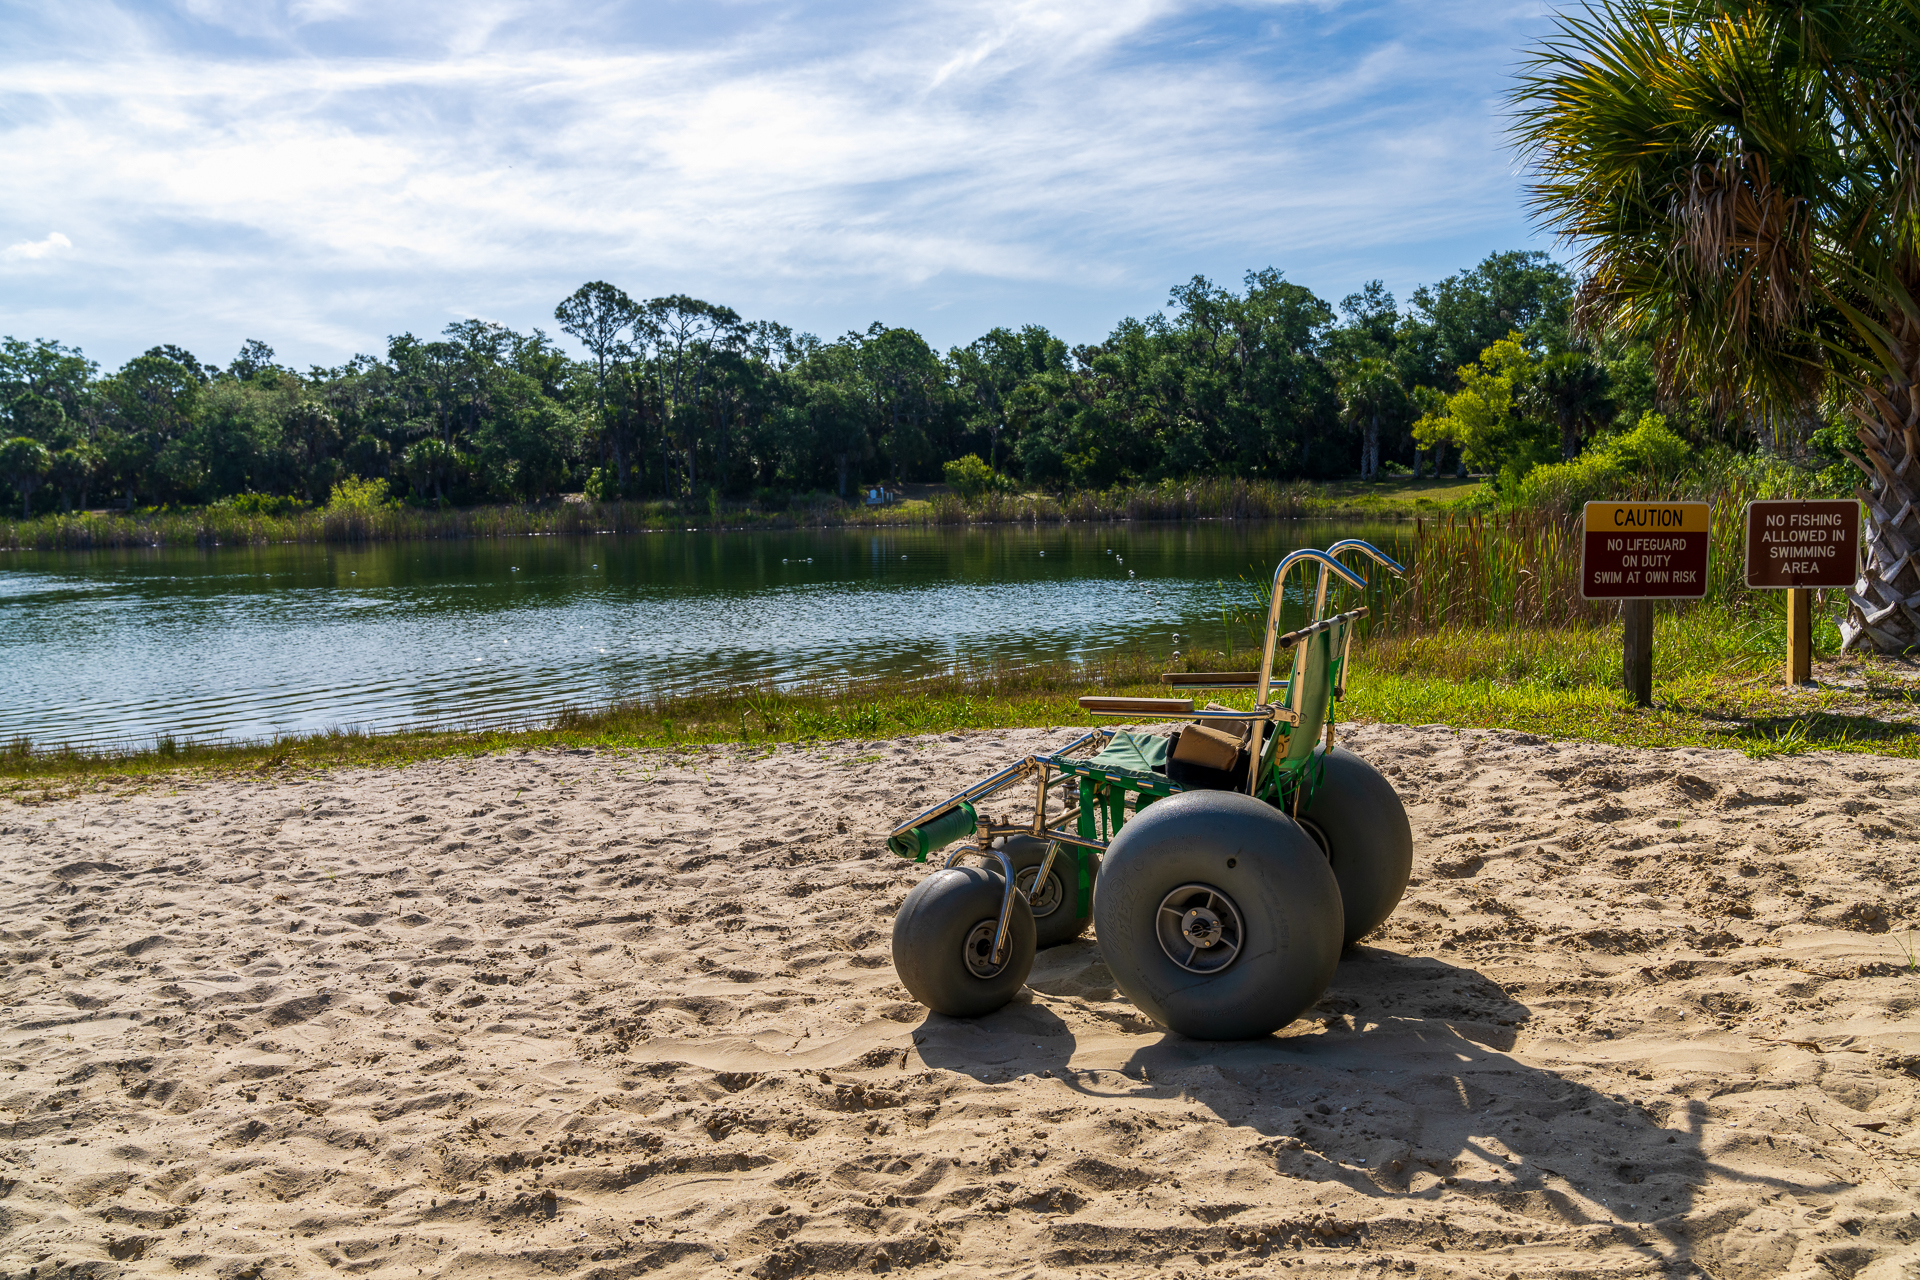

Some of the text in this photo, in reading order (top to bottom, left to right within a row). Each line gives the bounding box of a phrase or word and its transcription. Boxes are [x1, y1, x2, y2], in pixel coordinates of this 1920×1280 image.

[1614, 508, 1683, 527] CAUTION
[1766, 514, 1842, 527] NO FISHING
[1762, 529, 1845, 542] ALLOWED IN
[1607, 538, 1687, 551] NO LIFEGUARD
[1769, 545, 1836, 558] SWIMMING
[1622, 555, 1671, 567] ON DUTY
[1781, 562, 1820, 574] AREA
[1594, 571, 1697, 584] SWIM AT OWN RISK
